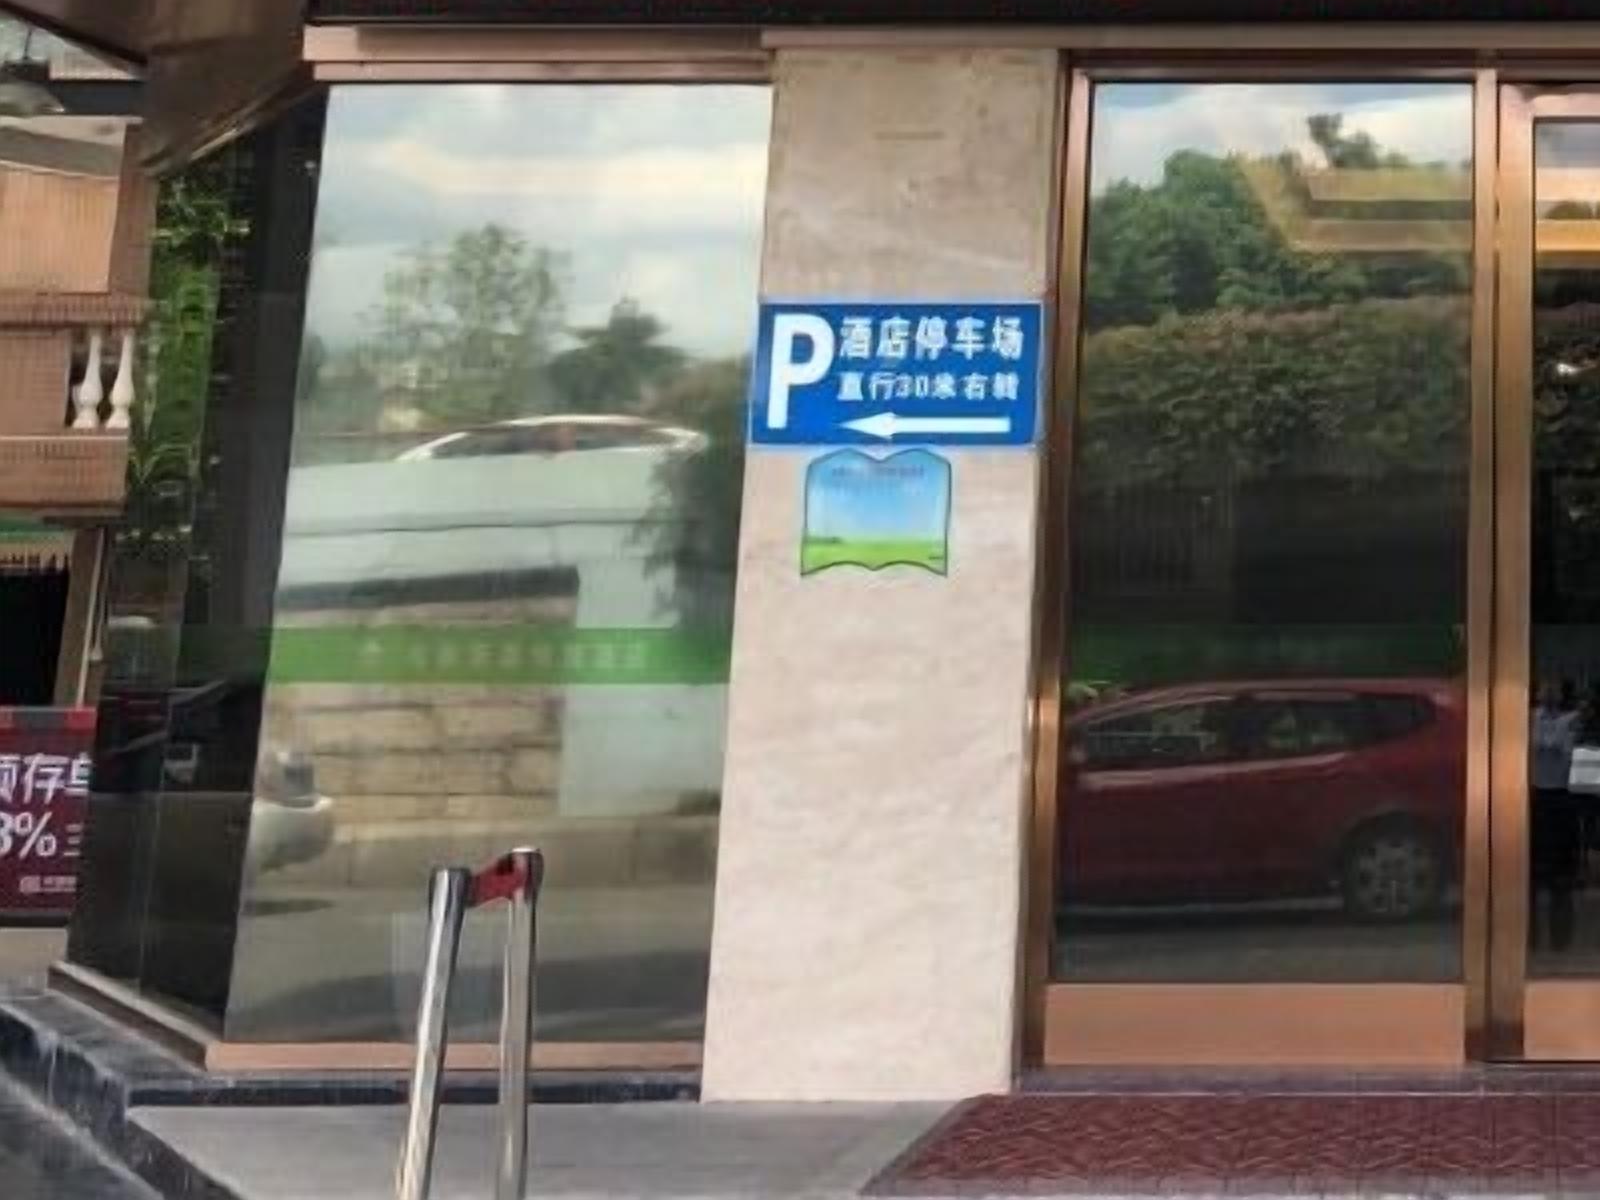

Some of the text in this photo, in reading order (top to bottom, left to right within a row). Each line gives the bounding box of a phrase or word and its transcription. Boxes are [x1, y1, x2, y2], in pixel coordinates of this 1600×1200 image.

[767, 313, 834, 429] P
[840, 315, 1024, 360] 酒店停车场
